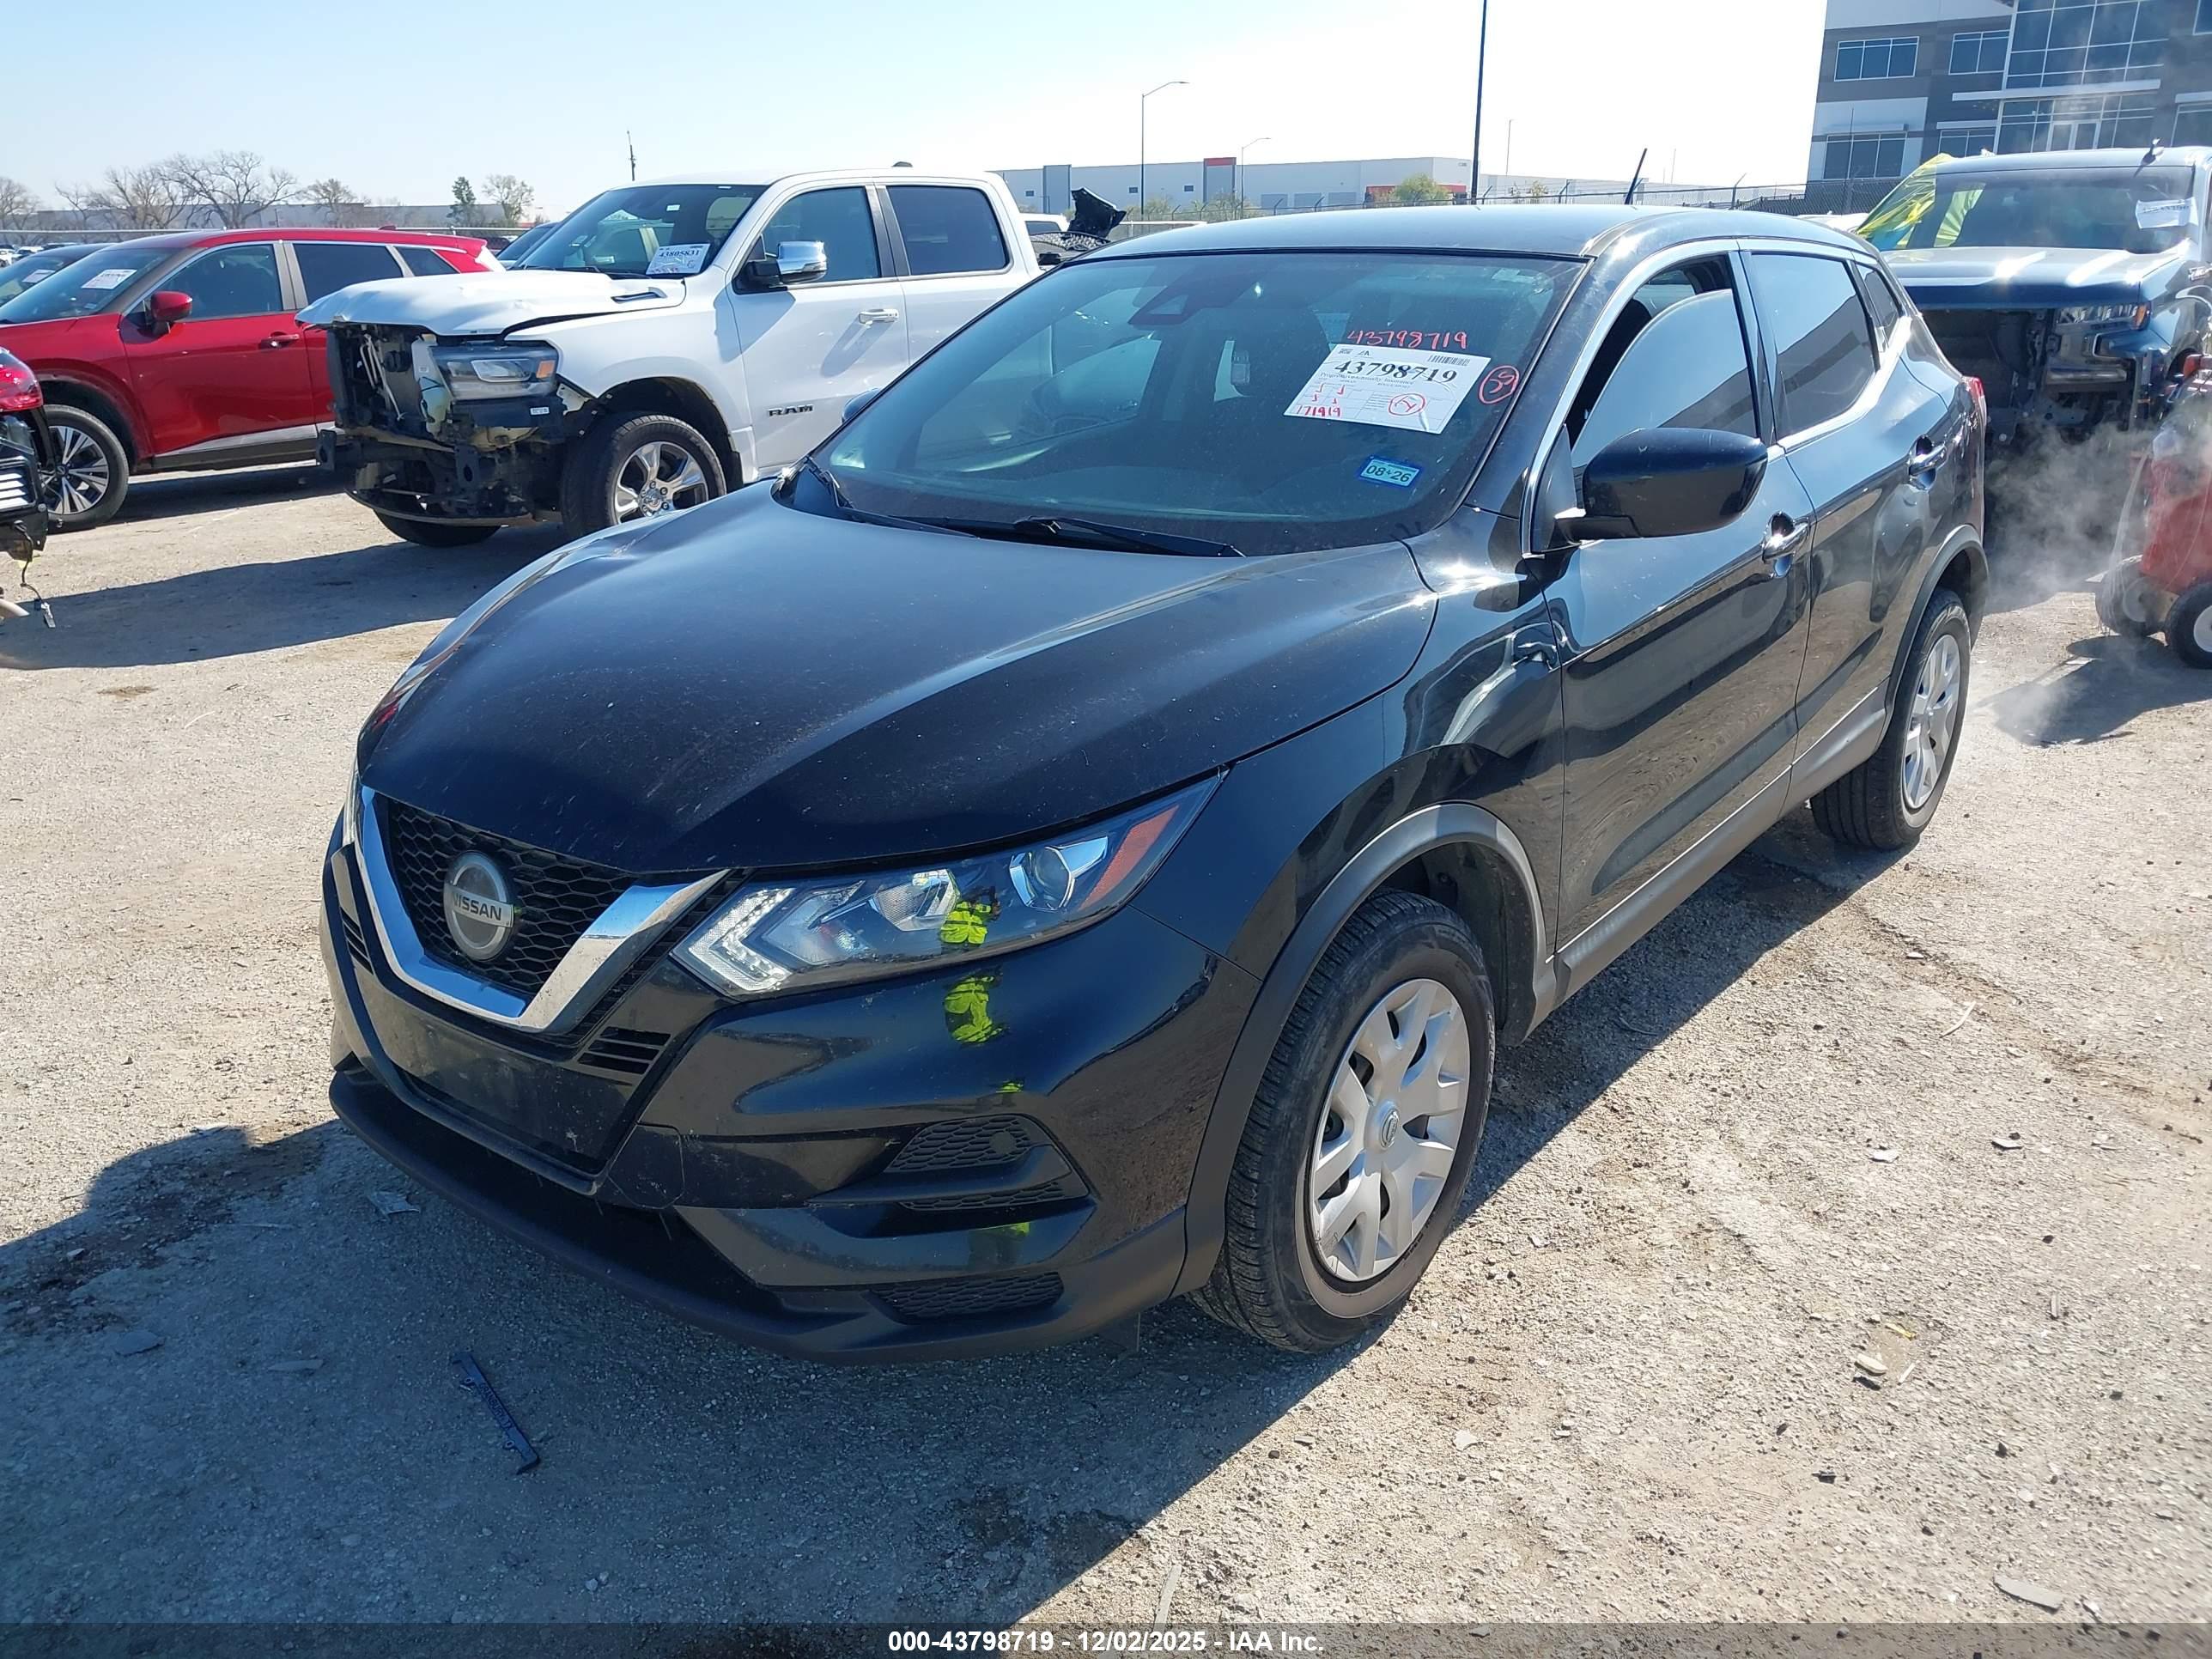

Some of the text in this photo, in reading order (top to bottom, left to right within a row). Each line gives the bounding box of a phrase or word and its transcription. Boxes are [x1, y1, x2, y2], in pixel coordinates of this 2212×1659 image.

[1347, 330, 1468, 350] 43798719
[1334, 360, 1457, 383] 43798719
[768, 404, 814, 416] RAM
[453, 893, 502, 921] NISSAN
